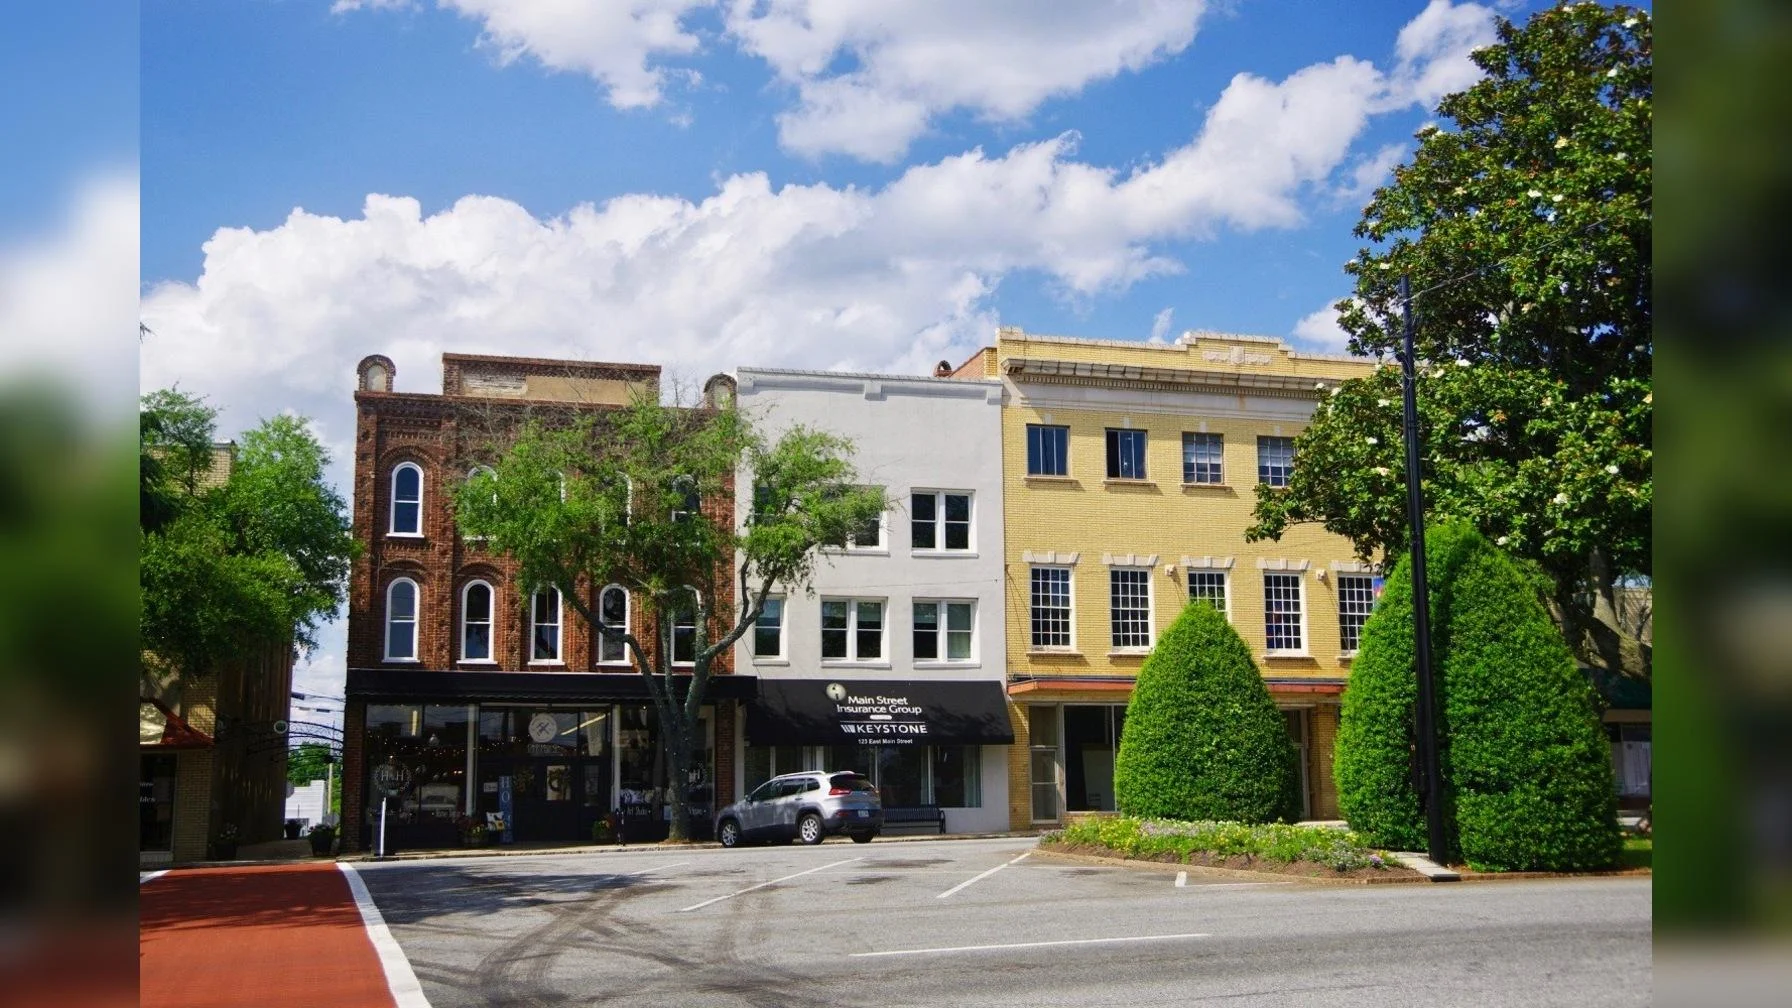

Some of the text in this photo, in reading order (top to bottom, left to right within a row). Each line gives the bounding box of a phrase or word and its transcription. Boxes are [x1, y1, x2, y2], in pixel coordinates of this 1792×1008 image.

[848, 696, 908, 705] Main Street
[836, 704, 922, 715] Insurance Group
[856, 724, 928, 734] KEYSTONE
